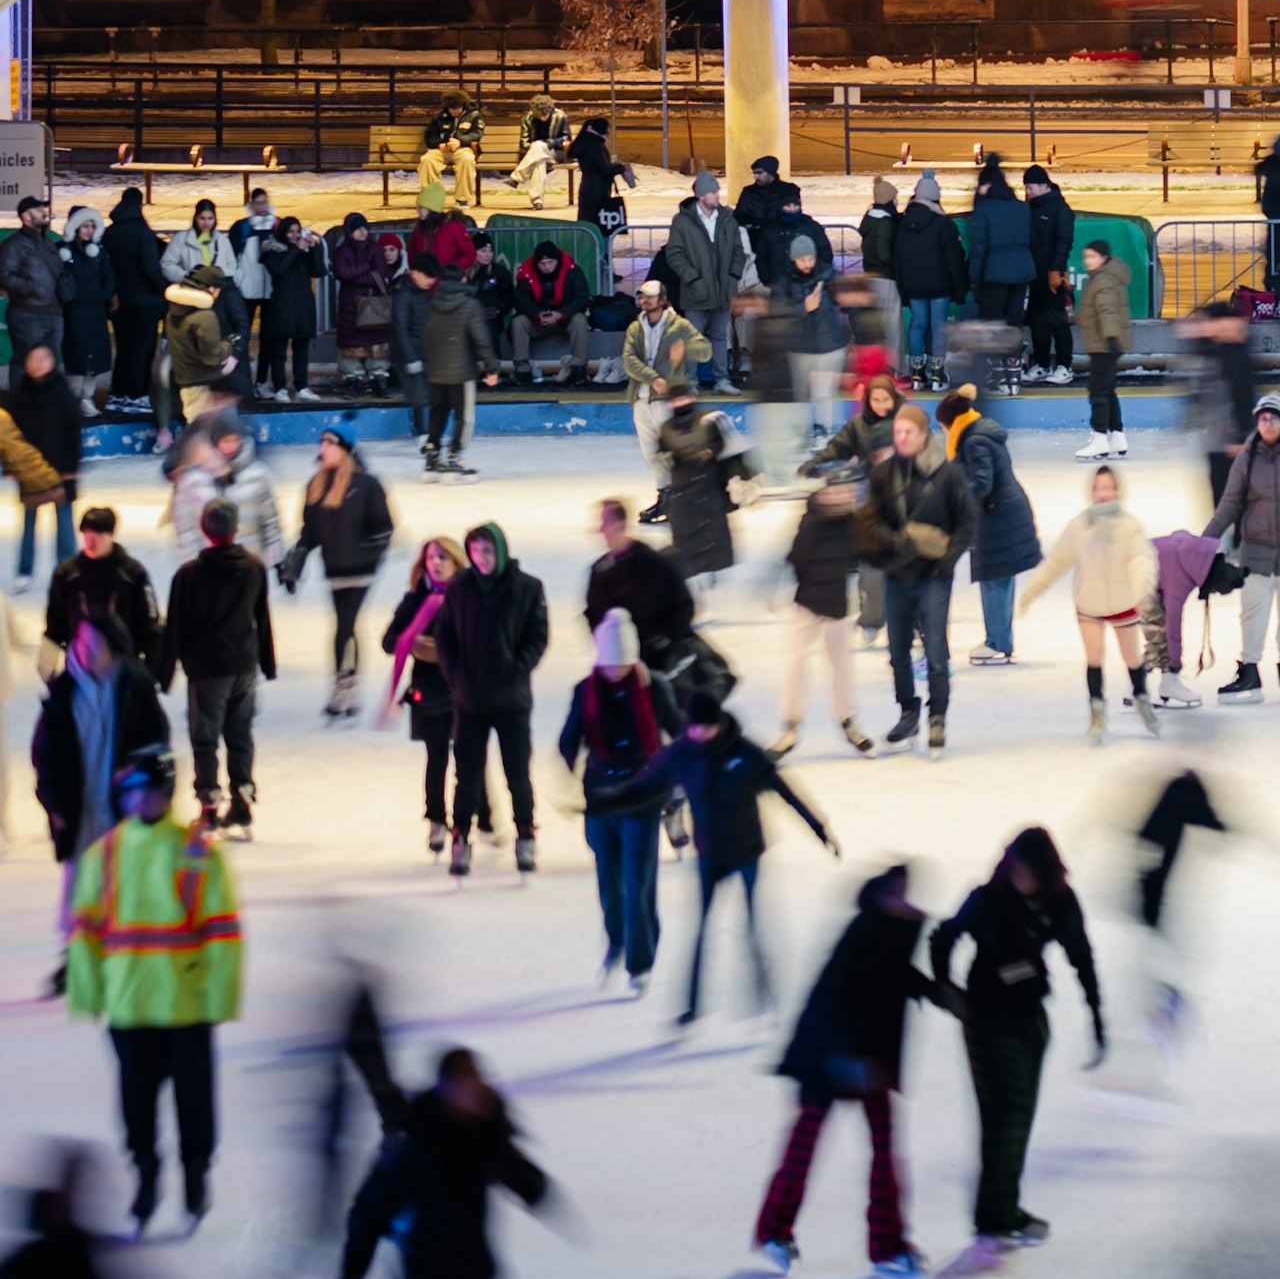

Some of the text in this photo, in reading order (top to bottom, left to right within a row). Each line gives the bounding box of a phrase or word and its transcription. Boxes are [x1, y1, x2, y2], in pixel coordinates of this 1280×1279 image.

[0, 152, 35, 167] icles
[0, 181, 19, 195] int
[598, 205, 625, 230] tpl
